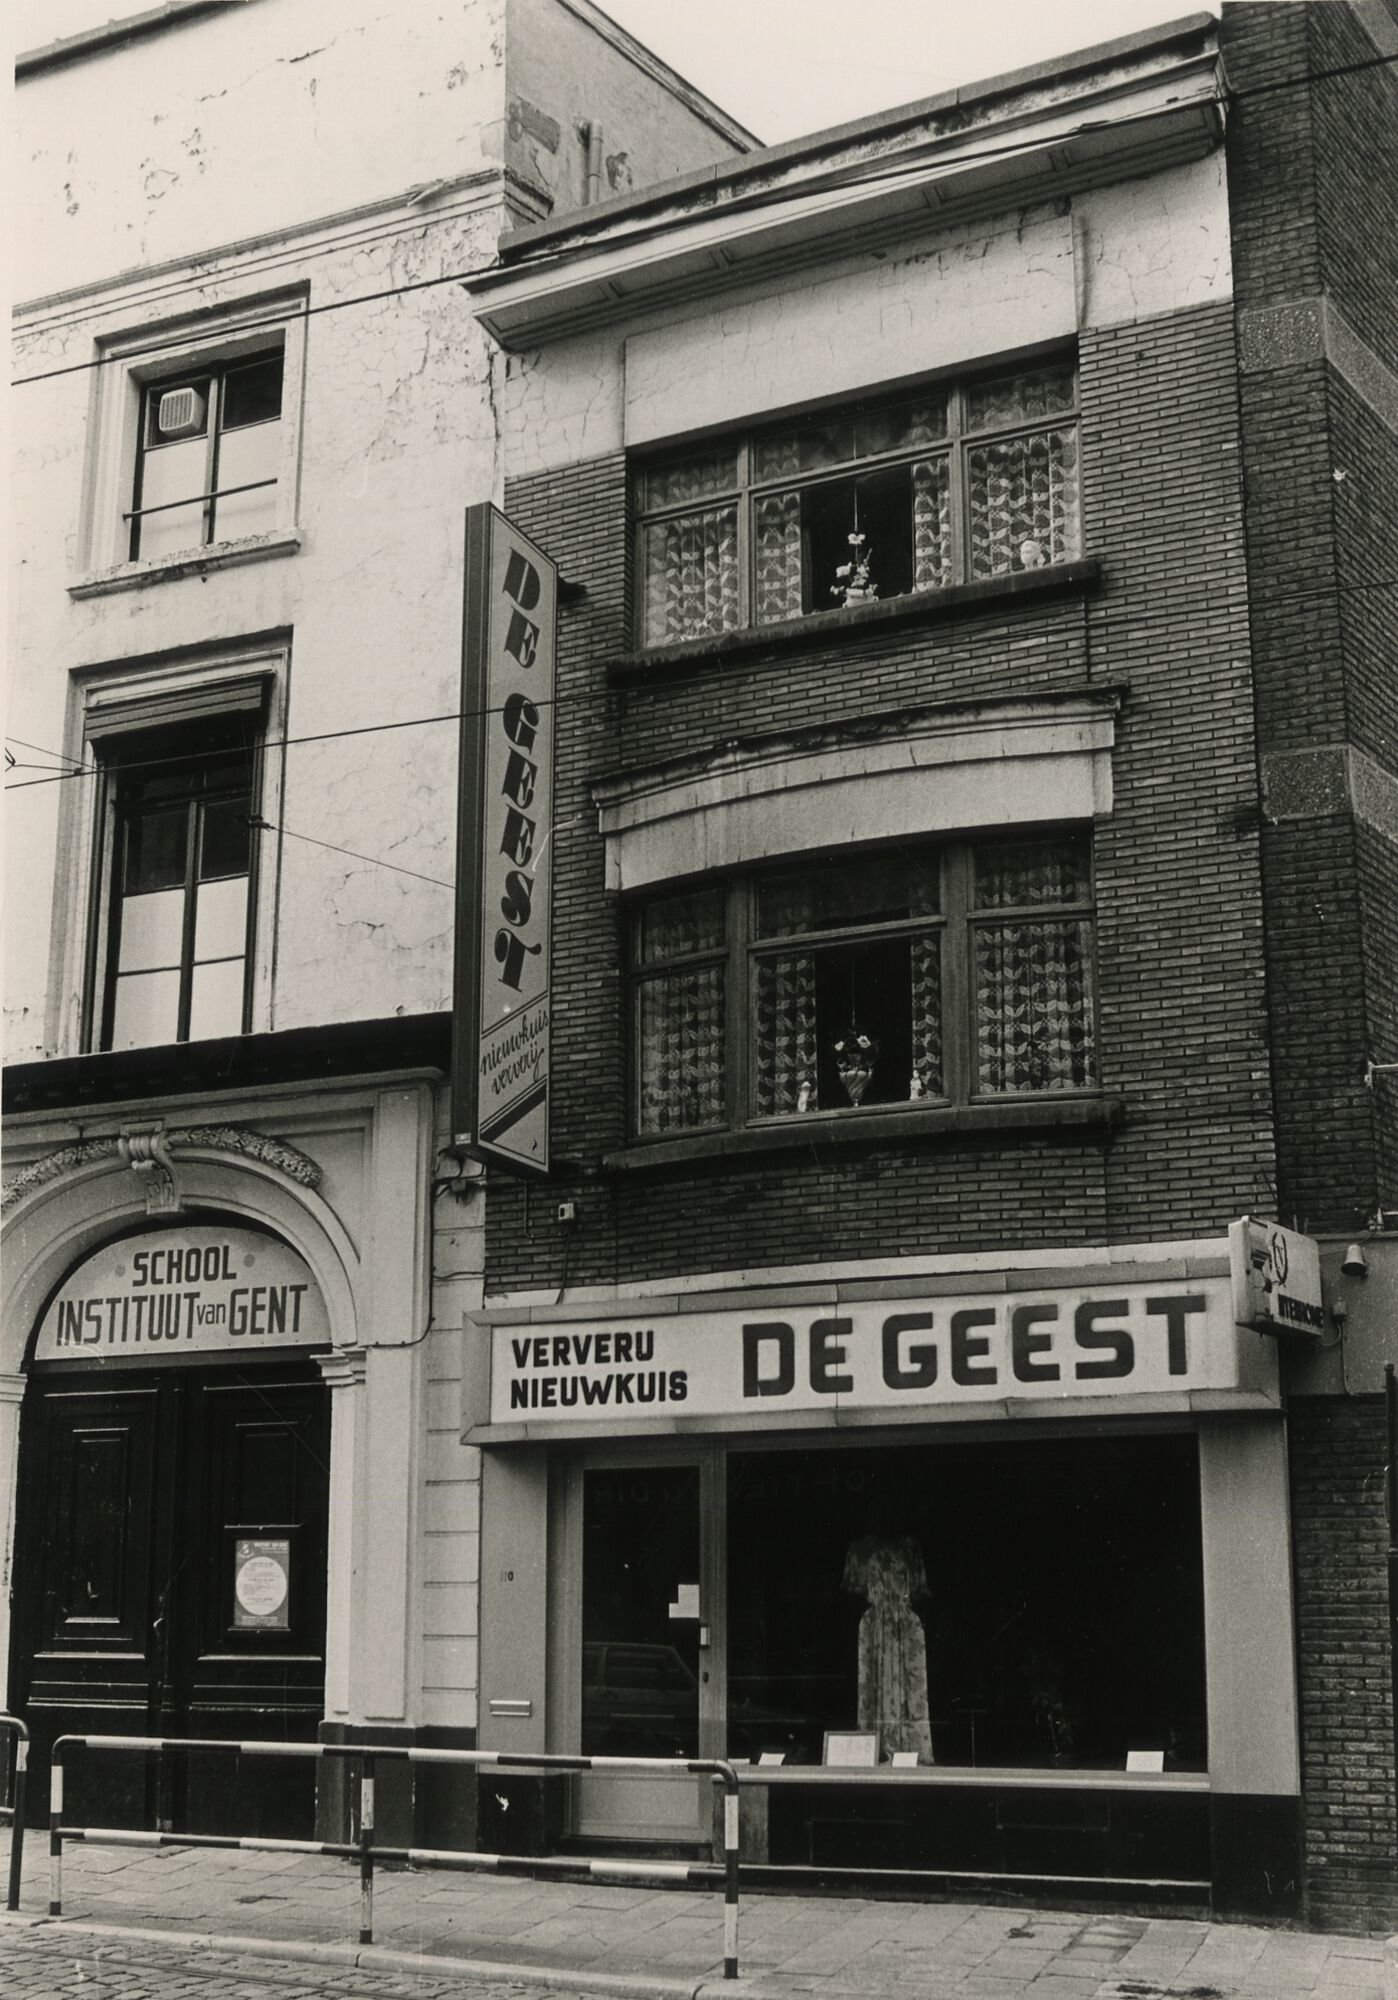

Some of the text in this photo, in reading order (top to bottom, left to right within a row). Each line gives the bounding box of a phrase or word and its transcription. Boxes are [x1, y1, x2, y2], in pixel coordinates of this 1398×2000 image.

[494, 547, 541, 993] DE GEEST
[480, 1009, 549, 1076] nieuwkuis
[491, 1041, 545, 1095] ververij
[132, 1245, 238, 1287] SCHOOL
[56, 1283, 308, 1347] INSTITUUT van GENT
[742, 1294, 1207, 1398] DE GEEST
[511, 1370, 688, 1409] NIEUWKUIS
